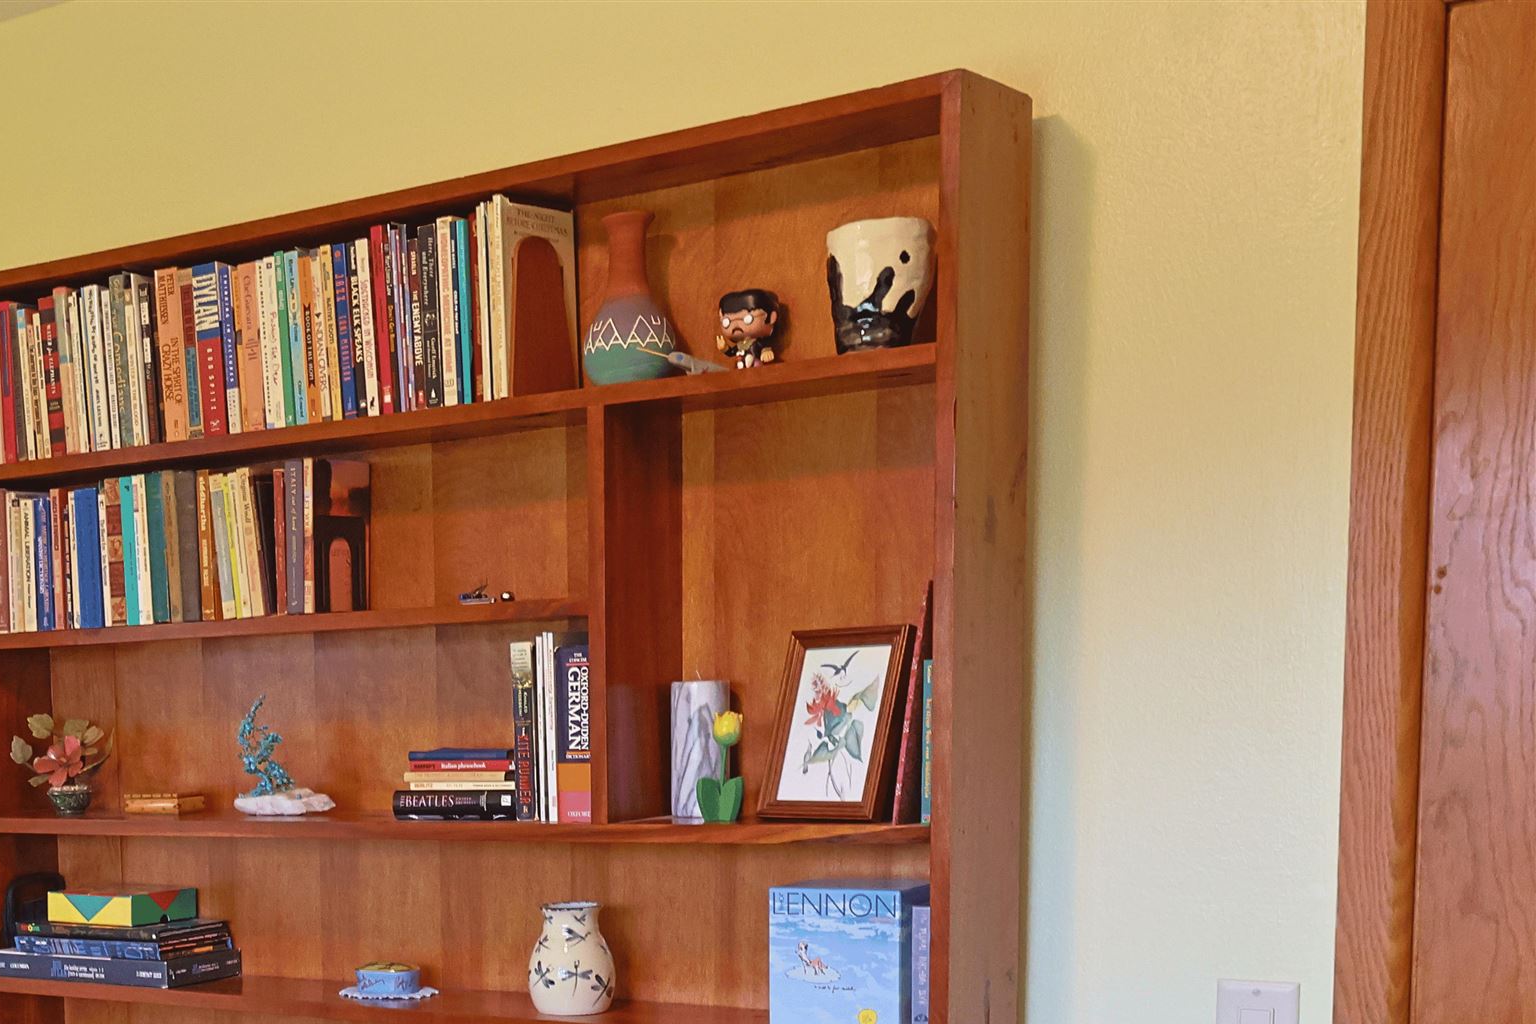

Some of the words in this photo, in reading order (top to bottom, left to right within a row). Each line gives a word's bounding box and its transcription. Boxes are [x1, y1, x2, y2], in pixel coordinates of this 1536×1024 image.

[440, 232, 450, 292] HOMEOPATHIC
[166, 274, 175, 296] PETER
[336, 274, 346, 302] JAZZ
[350, 276, 359, 306] BLACK
[192, 273, 219, 331] DYLAN
[442, 294, 450, 334] MEDICINE
[226, 324, 232, 334] IN
[412, 302, 420, 333] ENEMY
[171, 337, 179, 348] IN
[316, 322, 324, 357] INDIAN
[354, 328, 363, 362] SPEAKS
[414, 336, 423, 366] ABOVE
[445, 338, 450, 348] AT
[162, 344, 170, 371] CRAZY
[172, 349, 180, 365] THE
[340, 338, 350, 382] MORRISON
[366, 340, 374, 378] WISCONSIN
[114, 332, 126, 414] Comedians
[164, 374, 172, 402] HORSE
[173, 366, 181, 391] SPIRIT
[318, 358, 328, 392] GIVERS
[174, 392, 182, 405] OF
[208, 374, 216, 410] SPITZ
[568, 666, 581, 750] GERMAN
[580, 666, 589, 750] OXFORD-DUDEN
[518, 735, 530, 758] KITE
[518, 760, 531, 804] RUNNER
[405, 795, 454, 808] BEATLES
[772, 892, 896, 918] LENNON
